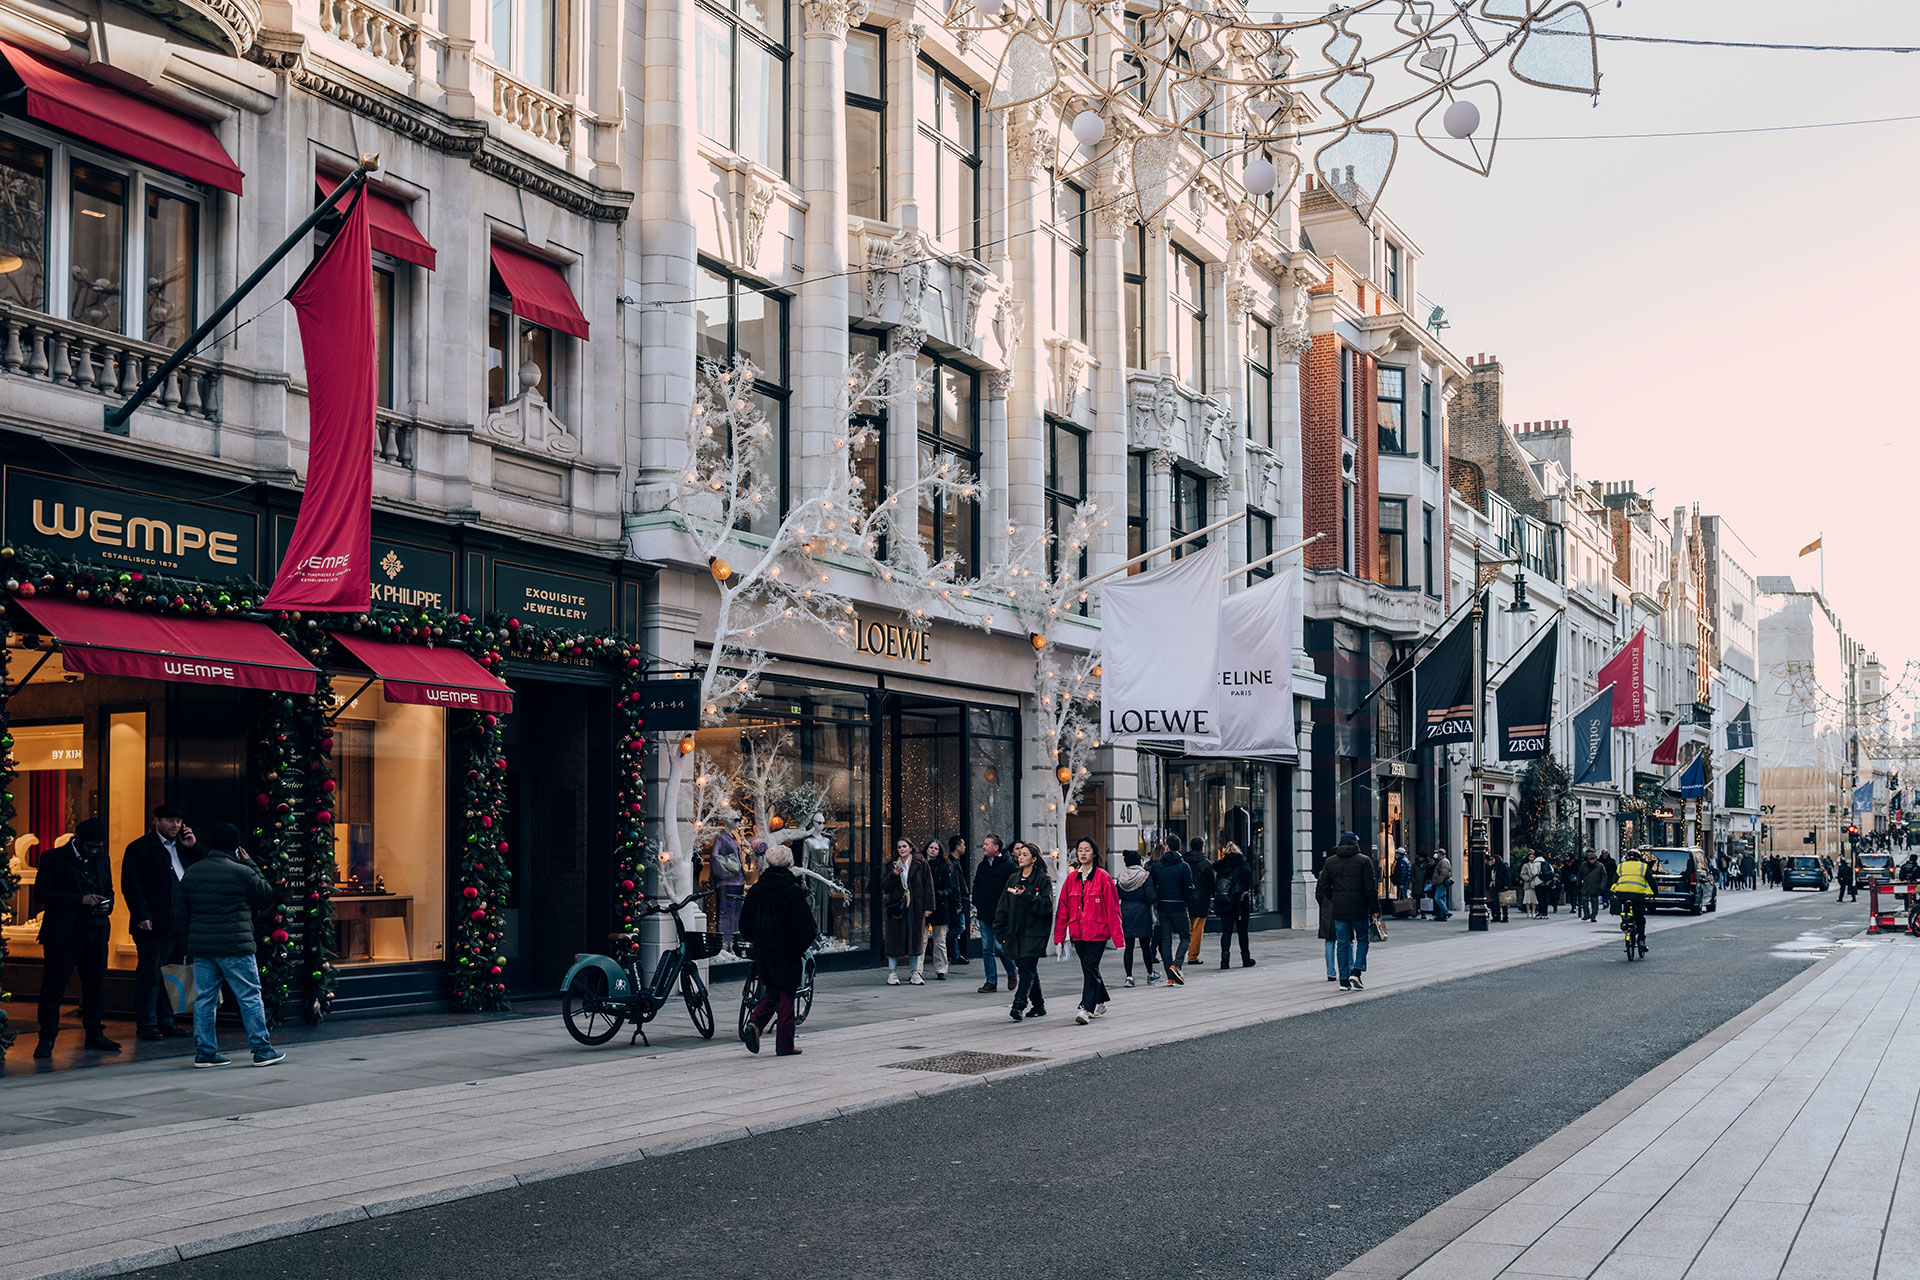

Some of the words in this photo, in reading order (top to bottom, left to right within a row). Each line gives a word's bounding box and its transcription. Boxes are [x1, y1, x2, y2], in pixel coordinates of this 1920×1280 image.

[33, 499, 238, 565] WEMPE
[102, 551, 156, 565] ESTABLISHED
[158, 560, 178, 569] 1878
[384, 585, 442, 610] PHILIPPE
[525, 587, 585, 606] EXQUISITE
[522, 602, 588, 621] JEWELLERY
[855, 618, 931, 663] LOEWE
[510, 649, 530, 660] NEW
[562, 656, 595, 668] STREET
[1632, 647, 1640, 689] RICHARD
[164, 661, 235, 679] WEMPE
[1217, 670, 1273, 685] ELINE
[426, 689, 479, 704] WEMPE
[1632, 690, 1641, 722] GREEN
[1109, 709, 1209, 734] LOEWE
[1427, 720, 1473, 739] ZEGNA
[52, 749, 64, 760] BY
[1120, 804, 1133, 824] 40
